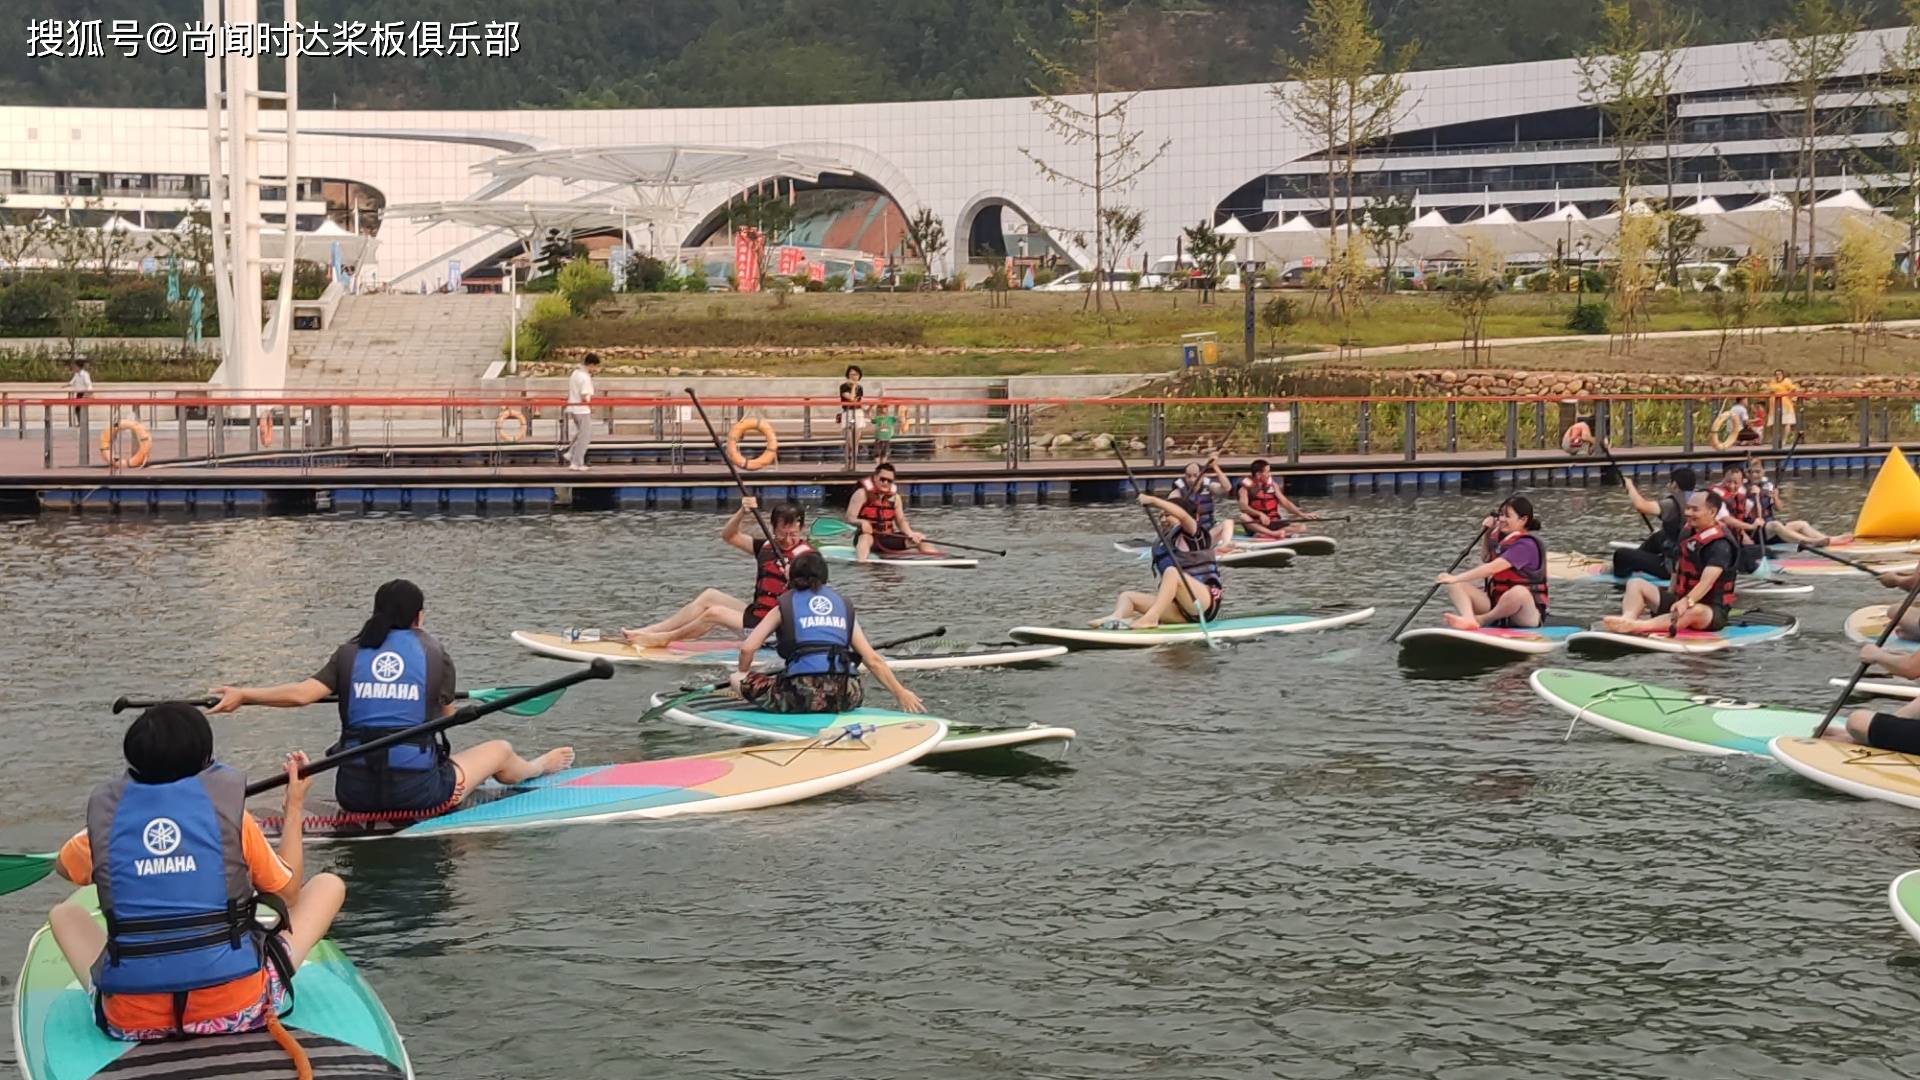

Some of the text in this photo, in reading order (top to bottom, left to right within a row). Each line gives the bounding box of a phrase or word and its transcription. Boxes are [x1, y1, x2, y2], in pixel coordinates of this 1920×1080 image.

[799, 616, 847, 630] YAMAHA
[353, 682, 419, 701] YAMAHA
[134, 855, 197, 876] YAMAHA
